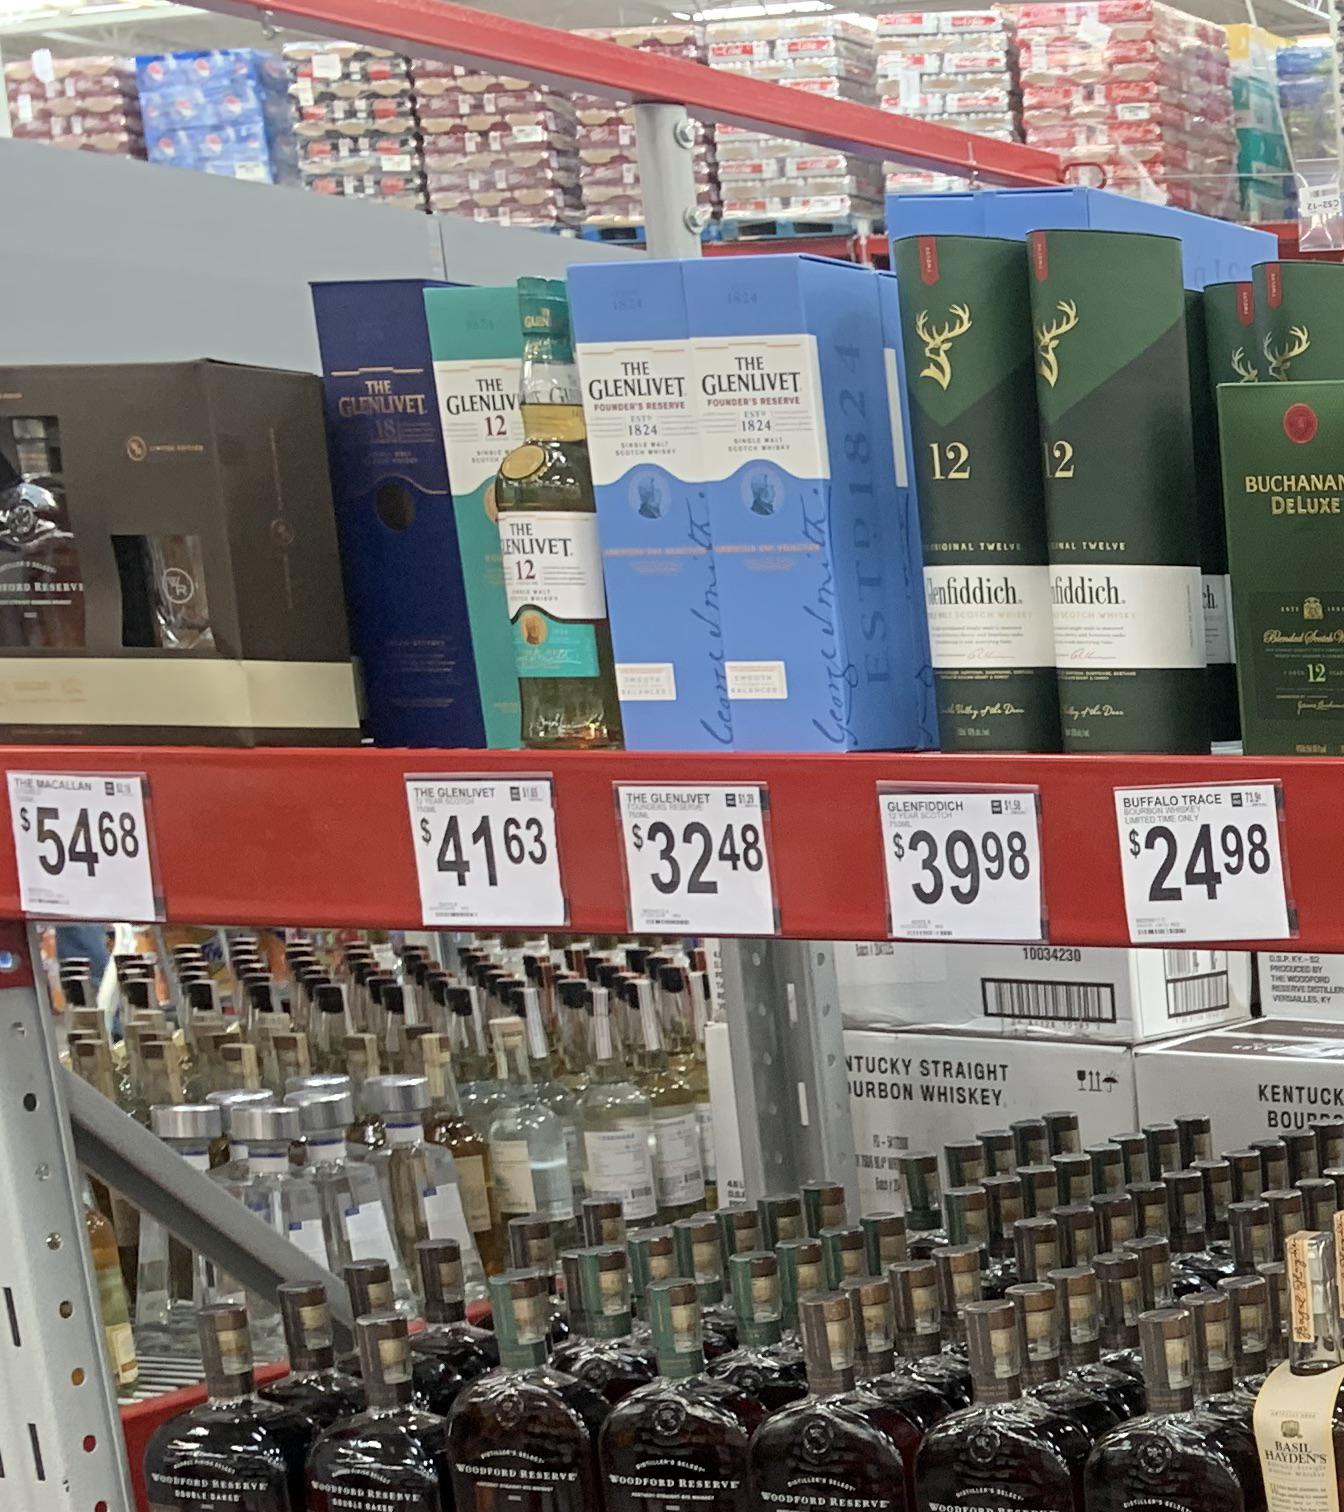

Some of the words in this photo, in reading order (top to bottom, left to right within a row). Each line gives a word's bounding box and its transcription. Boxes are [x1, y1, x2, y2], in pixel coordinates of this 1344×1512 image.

[622, 362, 650, 376] THE
[735, 356, 763, 371] THE
[590, 377, 686, 400] GLENLIVET
[702, 372, 801, 396] GLENLIVET
[929, 441, 970, 479] 12
[37, 780, 92, 791] MACALLAN
[414, 787, 435, 797] THE
[437, 787, 496, 798] GLENLIVET
[626, 793, 648, 803] THE
[651, 794, 710, 804] GLENLIVET
[1124, 796, 1178, 807] BUFFALO
[1182, 794, 1222, 805] TRACE
[888, 802, 963, 812] GLENFIDDICH
[921, 1085, 1002, 1108] WHISKEY
[1275, 1441, 1312, 1452] BASIL
[456, 1464, 516, 1477] WOODFORD
[520, 1471, 577, 1481] RESERVE
[609, 1475, 674, 1487] WOODFORD
[679, 1479, 739, 1489] RESERVE
